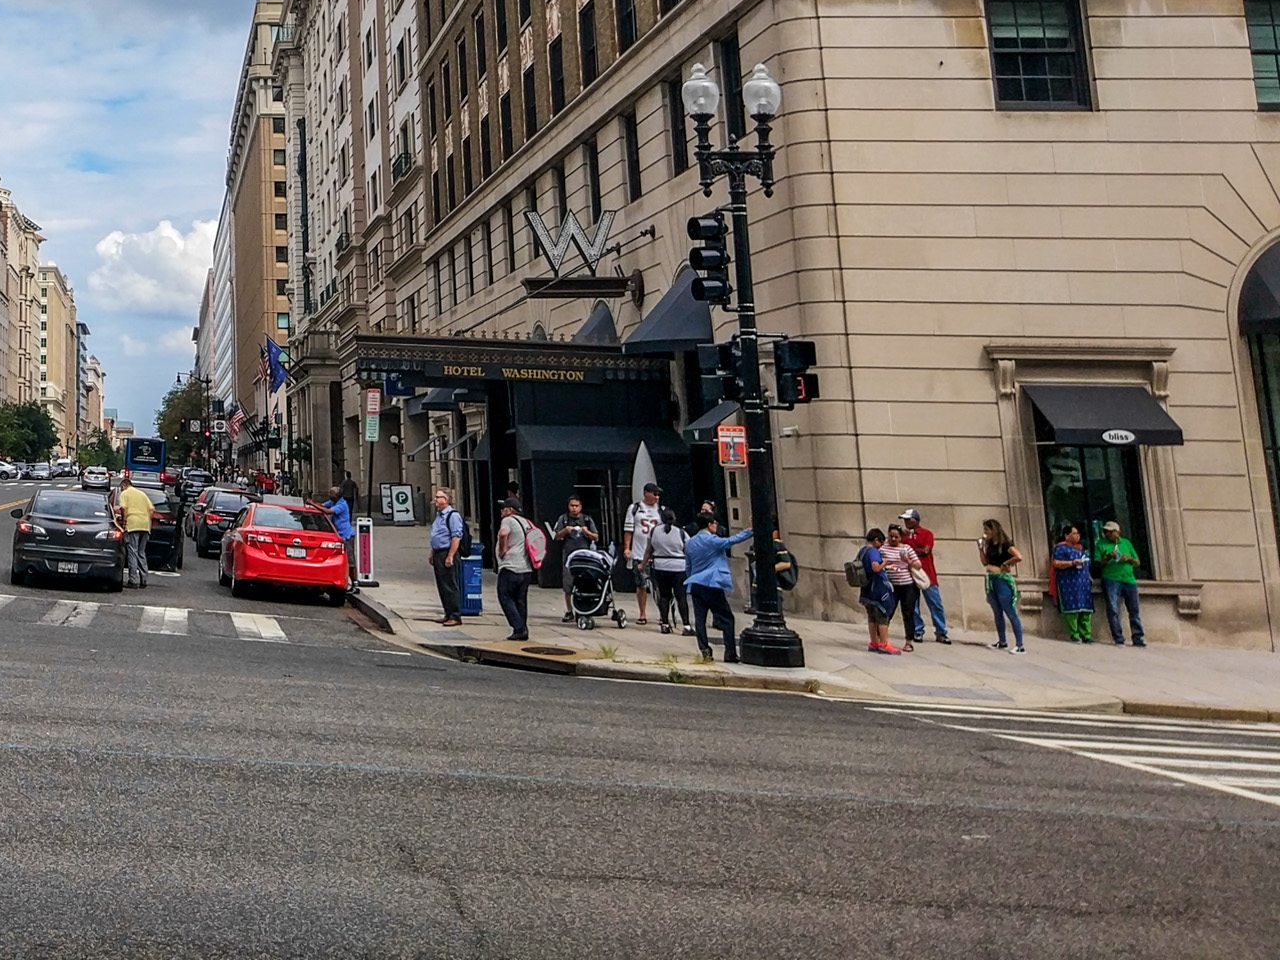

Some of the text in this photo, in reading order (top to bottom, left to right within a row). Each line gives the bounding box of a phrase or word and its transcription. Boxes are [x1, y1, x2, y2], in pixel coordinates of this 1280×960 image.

[523, 209, 616, 272] W
[443, 365, 584, 381] HOTEL WASHINGTON
[1108, 432, 1129, 441] bliss
[398, 493, 407, 503] P
